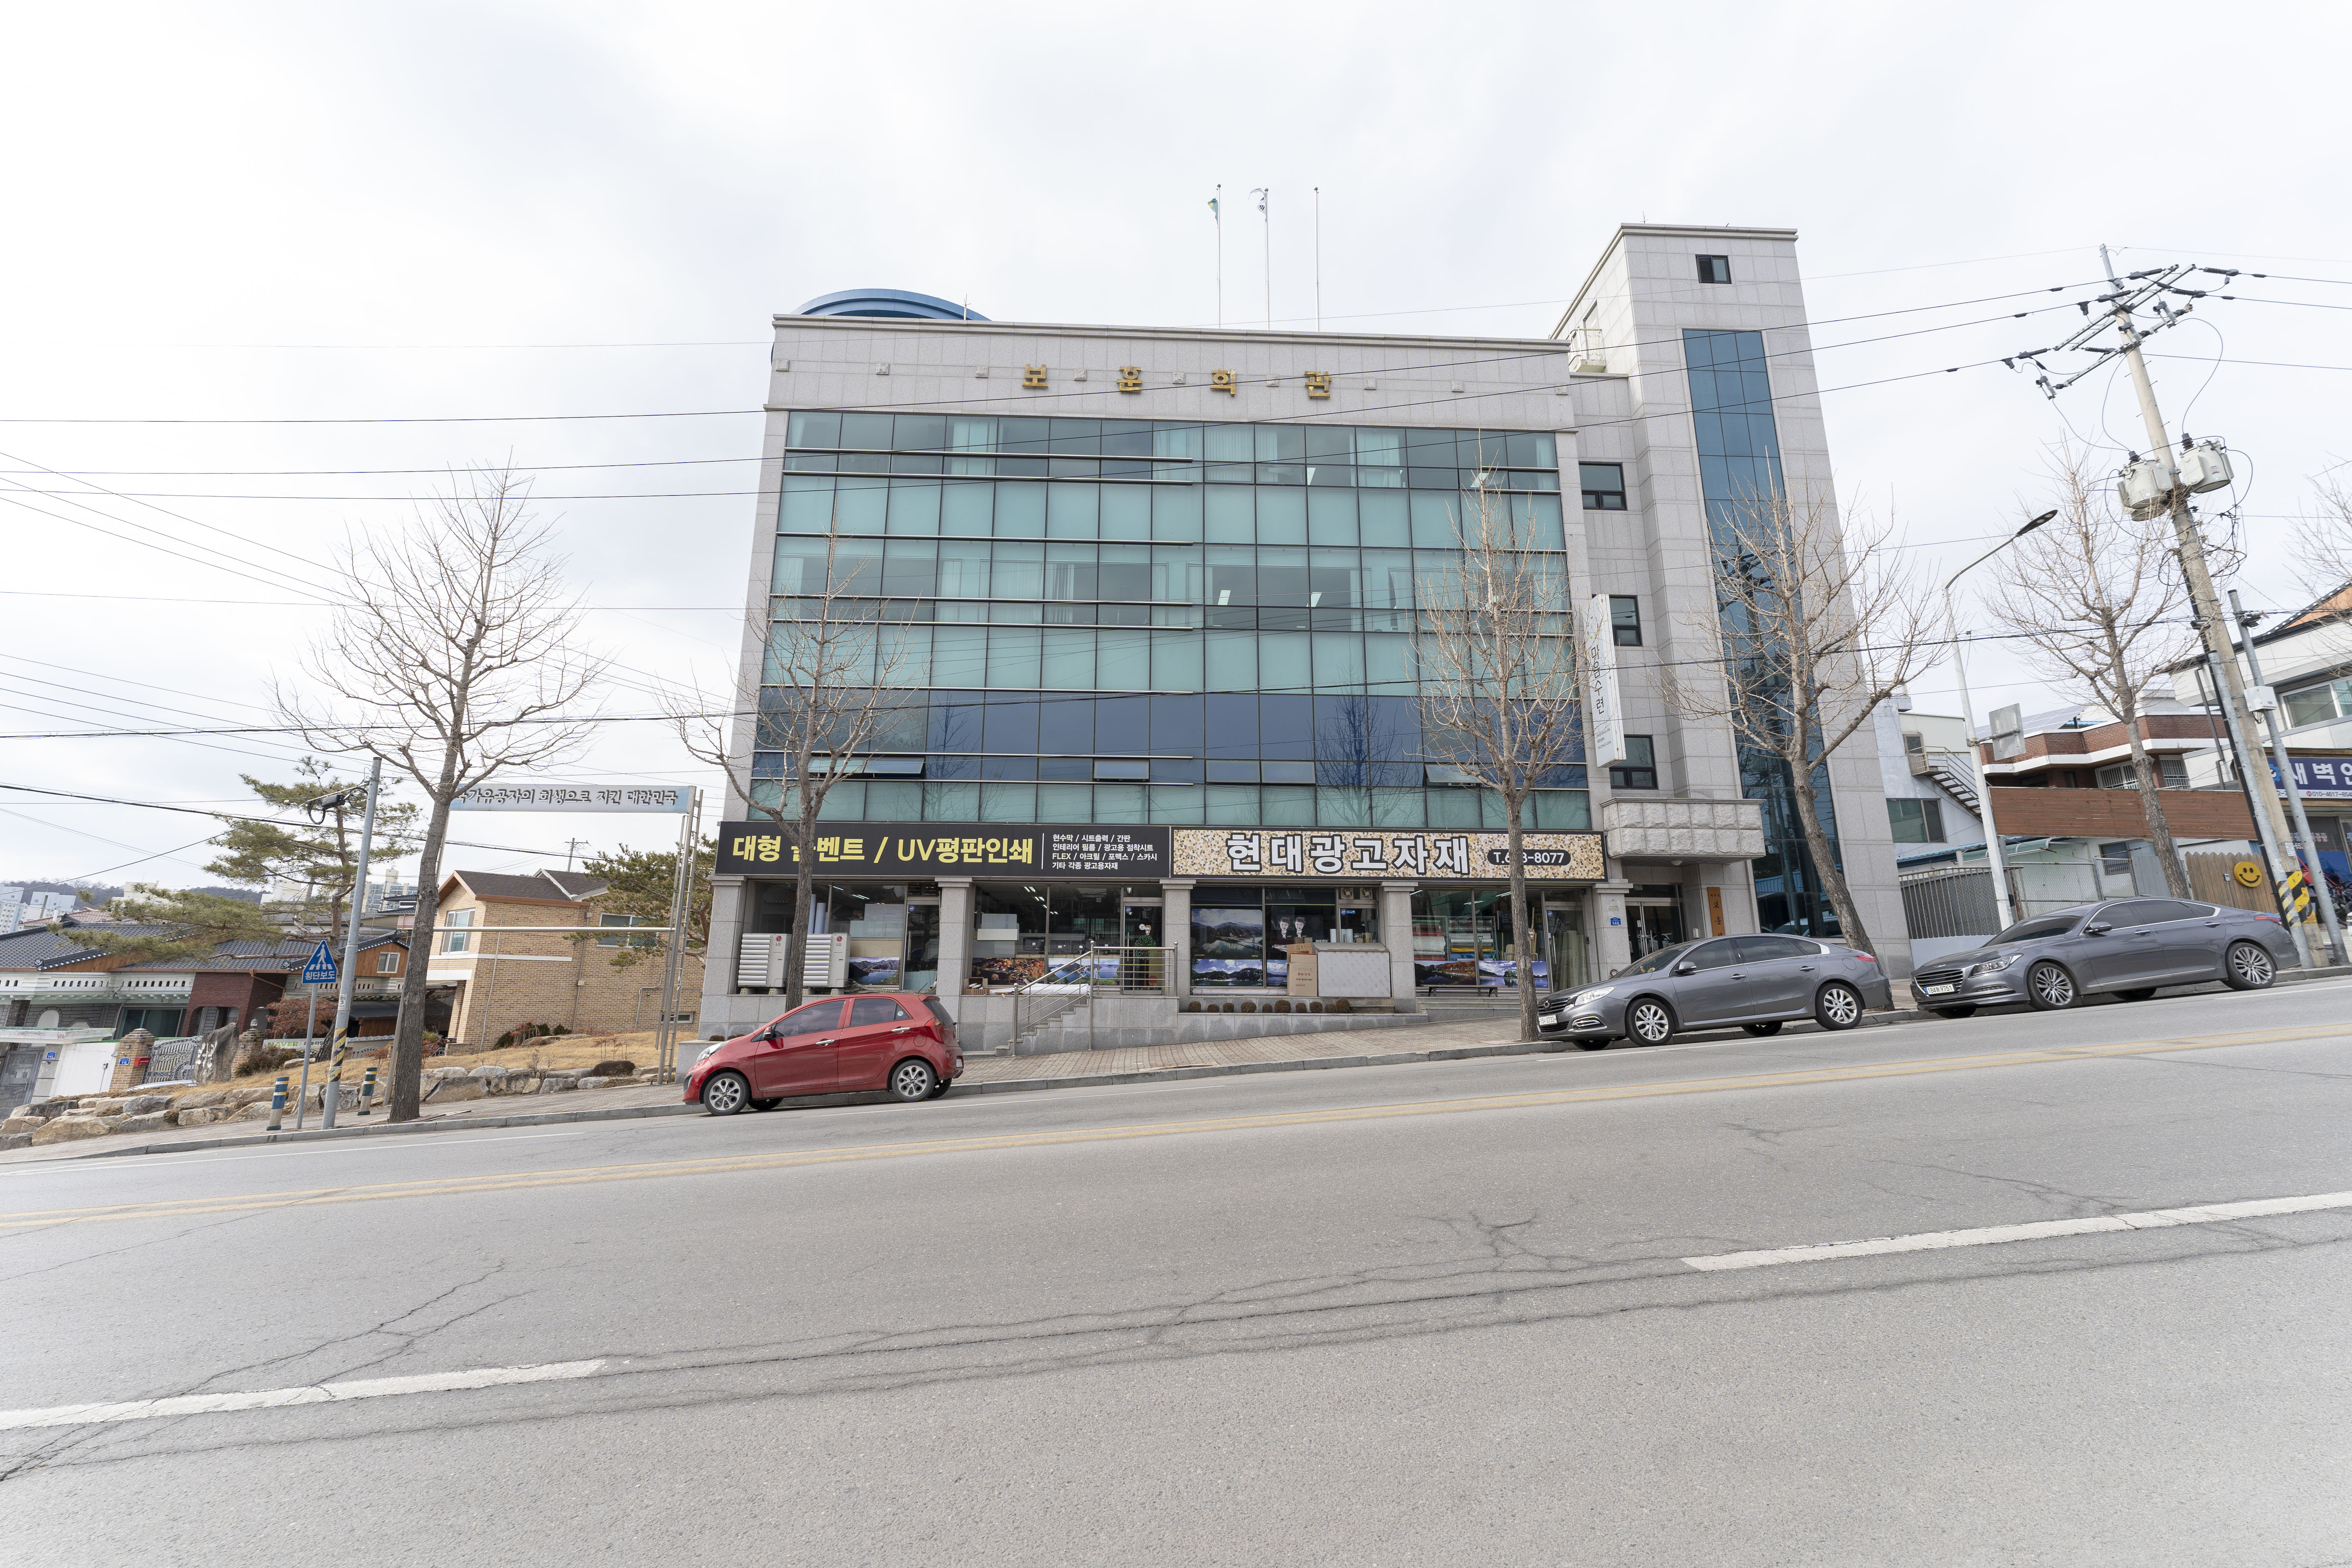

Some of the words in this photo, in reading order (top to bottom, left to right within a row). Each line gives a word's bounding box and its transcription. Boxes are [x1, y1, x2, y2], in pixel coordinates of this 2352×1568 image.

[1022, 364, 1332, 397] 보훈회관
[1591, 645, 1604, 714] 마음수련
[539, 789, 591, 805] 희생으로
[596, 790, 621, 805] 지킨
[627, 790, 678, 806] 대한민국
[733, 835, 781, 862] 대형
[898, 837, 1033, 864] UV평판인쇄
[1226, 833, 1470, 875] 현대광고자재
[1494, 852, 1564, 863] T.63-8077
[305, 971, 335, 980] 횡단보도
